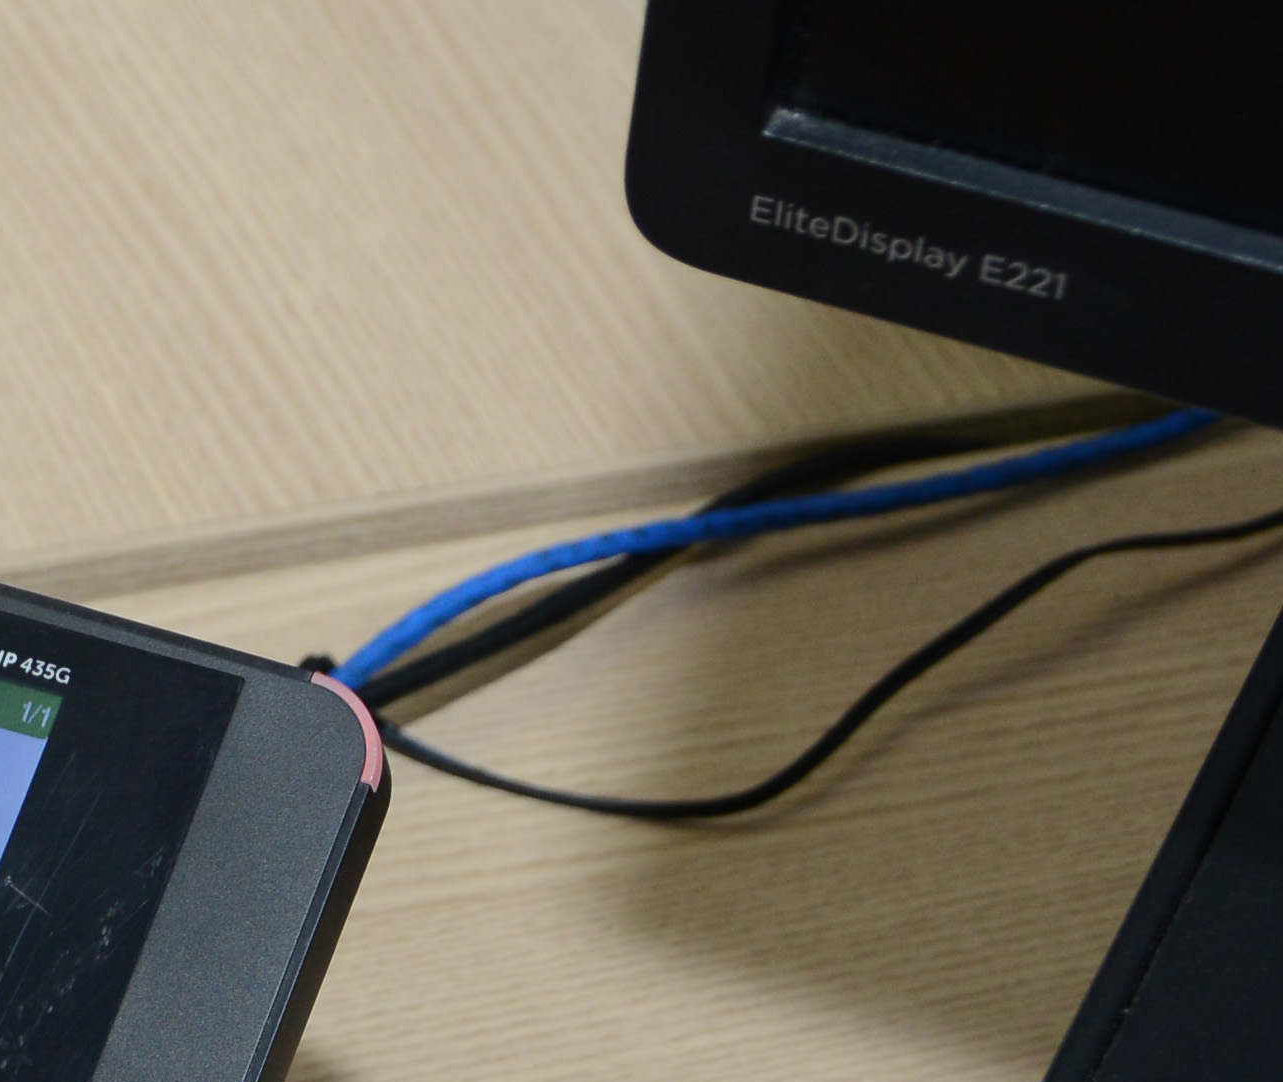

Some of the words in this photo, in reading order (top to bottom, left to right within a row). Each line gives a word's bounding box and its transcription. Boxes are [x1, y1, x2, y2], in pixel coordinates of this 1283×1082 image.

[749, 195, 969, 279] EliteDisplay
[979, 254, 1068, 300] E221
[19, 658, 71, 685] 435G
[21, 700, 52, 728] 1/1
